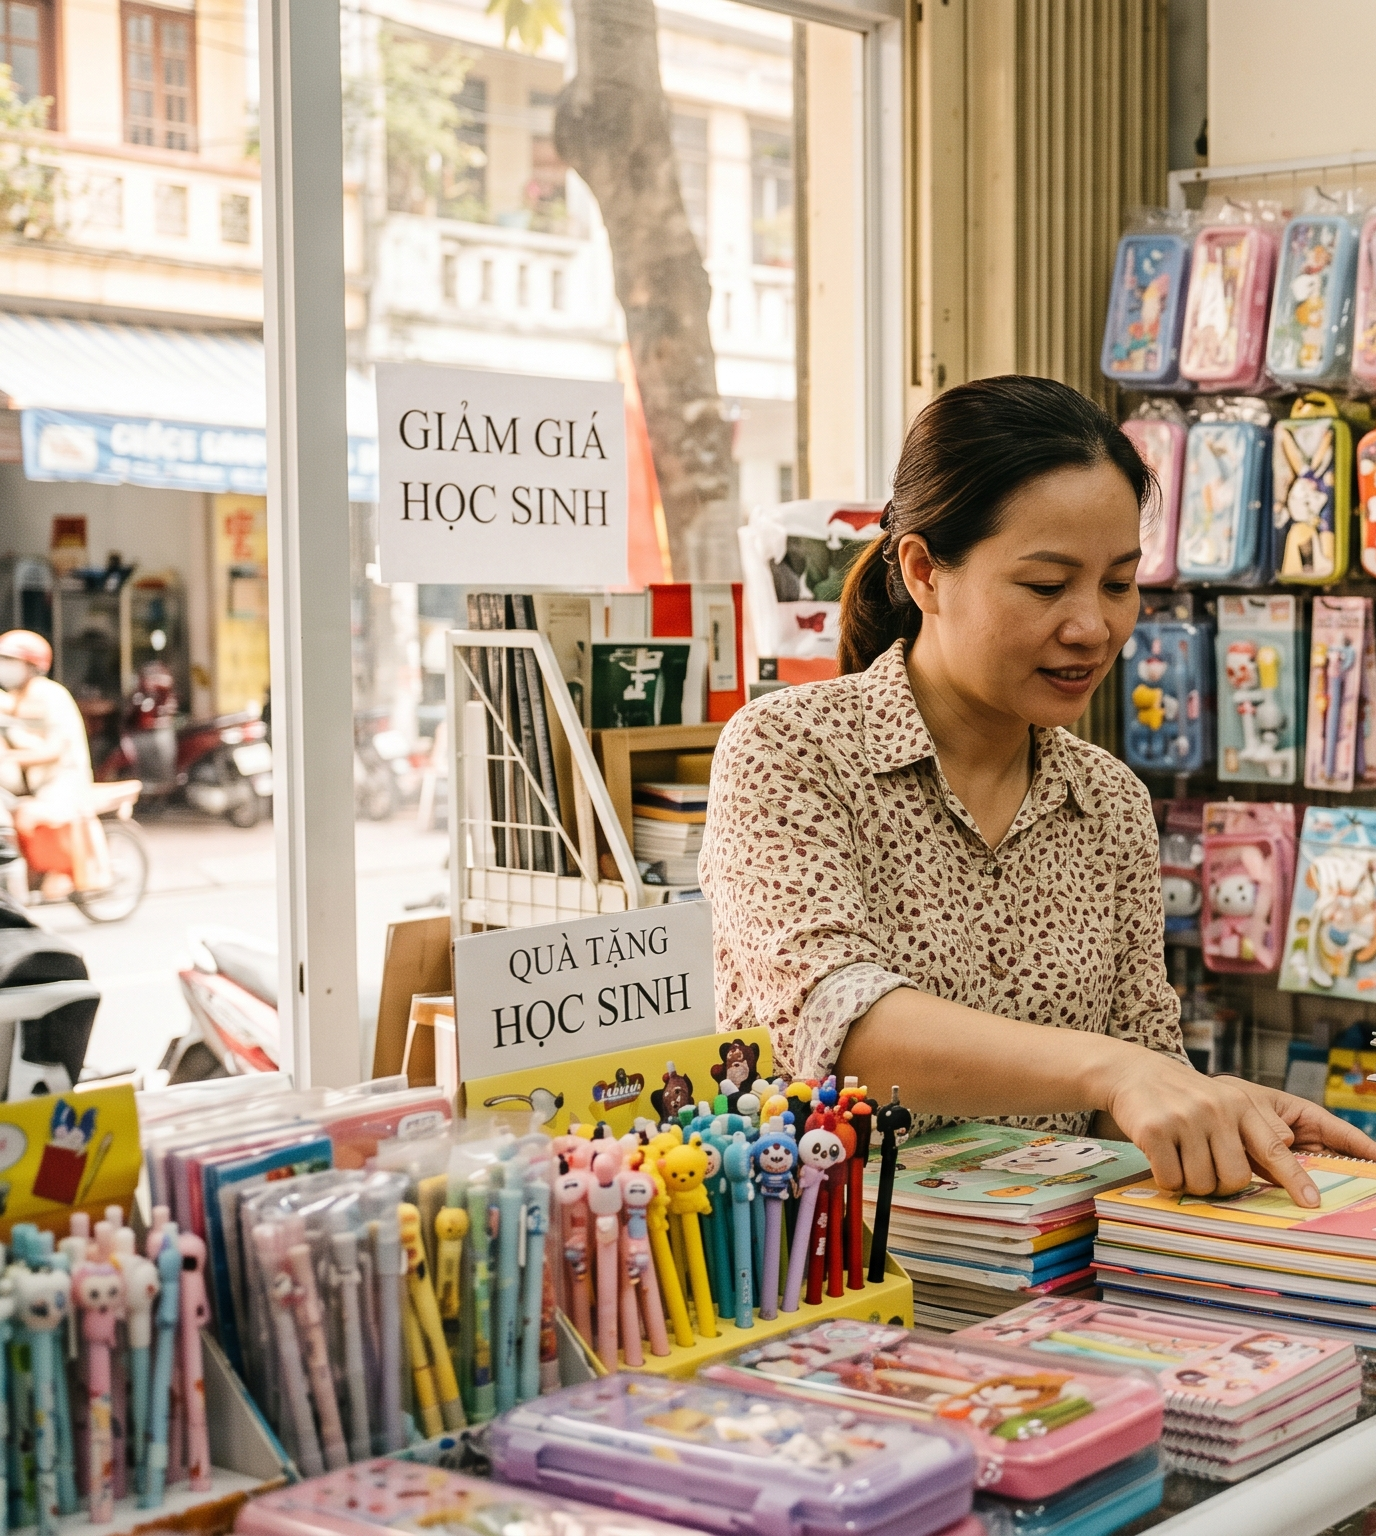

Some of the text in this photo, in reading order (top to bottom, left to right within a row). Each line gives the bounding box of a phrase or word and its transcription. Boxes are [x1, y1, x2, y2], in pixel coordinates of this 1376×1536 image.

[399, 401, 608, 460] GIẢM GIÁ
[400, 481, 609, 531] HỌC SINH
[508, 926, 669, 985] QUÀ TẶNG
[491, 972, 692, 1048] HỌC SINH
